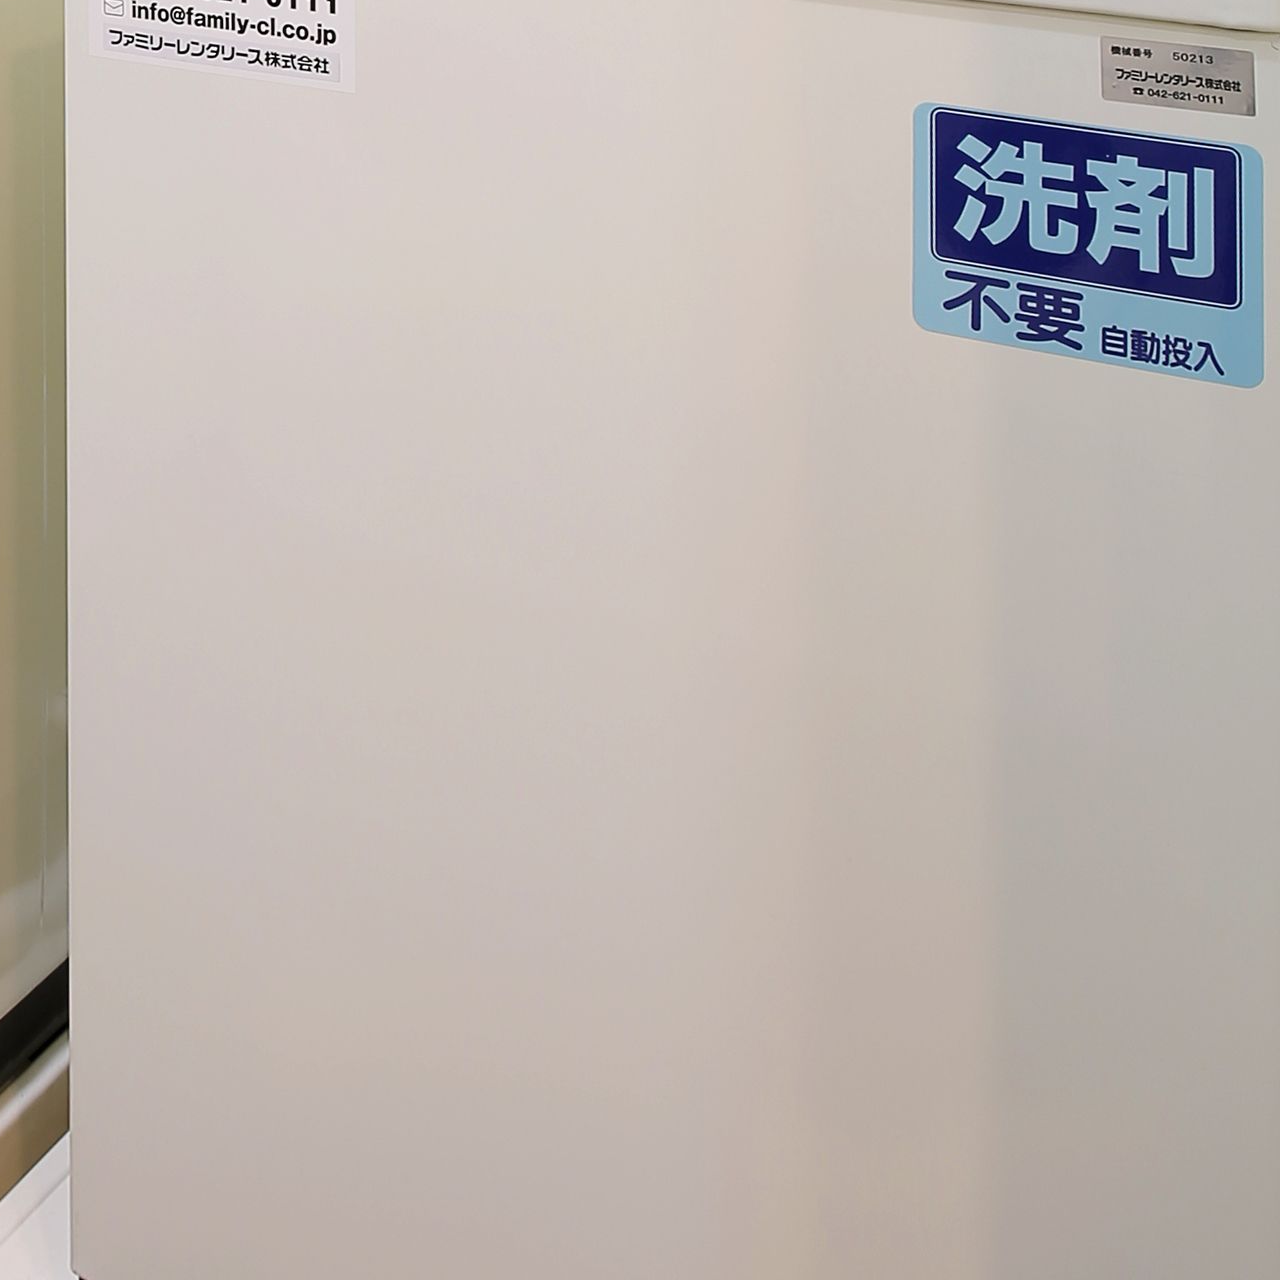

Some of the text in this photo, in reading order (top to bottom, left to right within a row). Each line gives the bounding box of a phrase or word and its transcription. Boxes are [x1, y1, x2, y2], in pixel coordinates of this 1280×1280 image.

[130, 0, 338, 46] info@family-cl.co.jp
[108, 28, 331, 75] ファミリーレンタリース株式会社
[1172, 51, 1214, 65] 50213
[1114, 67, 1243, 93] ファミリーレンタリース株式会社
[1147, 87, 1224, 105] 042-621-0111
[952, 132, 1216, 280] 洗剤
[942, 269, 1226, 377] 不要 自動投入
